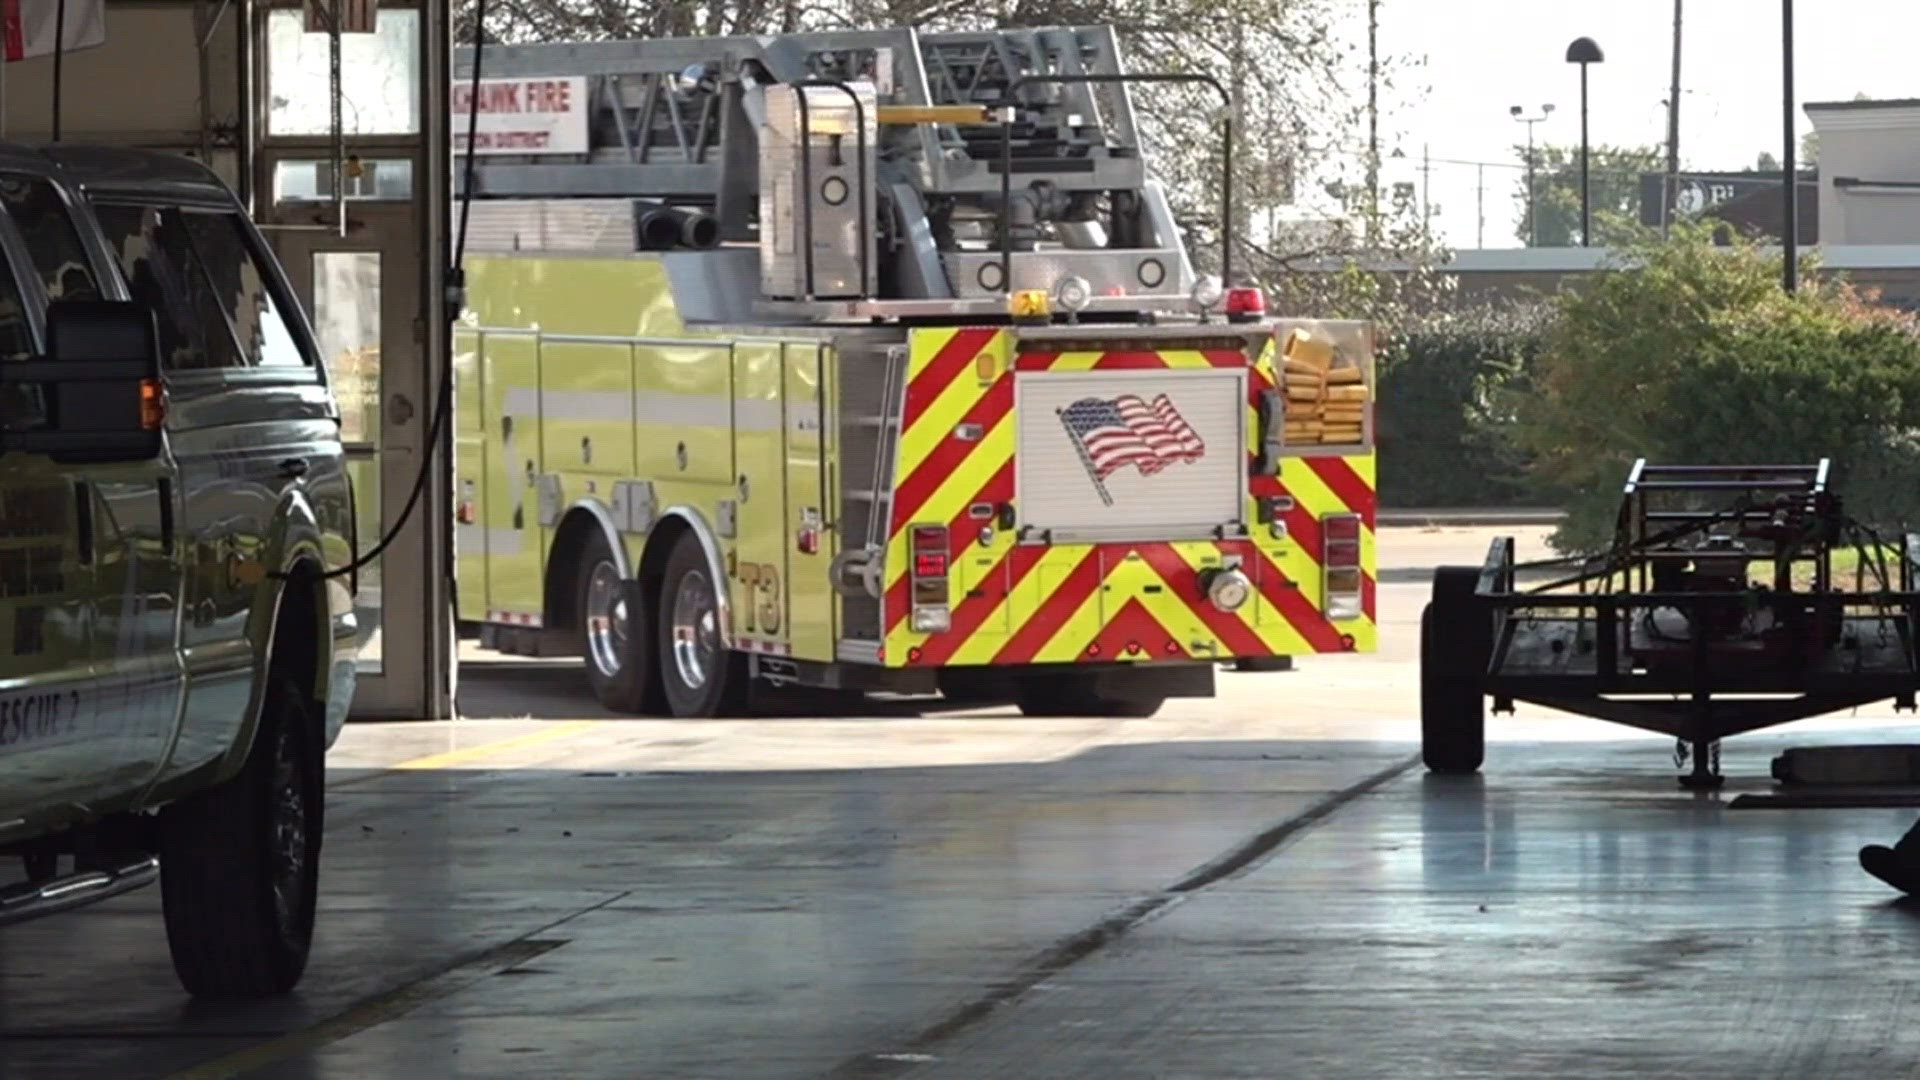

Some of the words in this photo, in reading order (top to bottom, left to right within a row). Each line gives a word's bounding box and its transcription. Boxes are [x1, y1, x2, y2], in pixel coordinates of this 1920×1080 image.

[526, 81, 570, 112] FIRE
[496, 131, 550, 148] DISTRICT
[737, 560, 781, 636] T3
